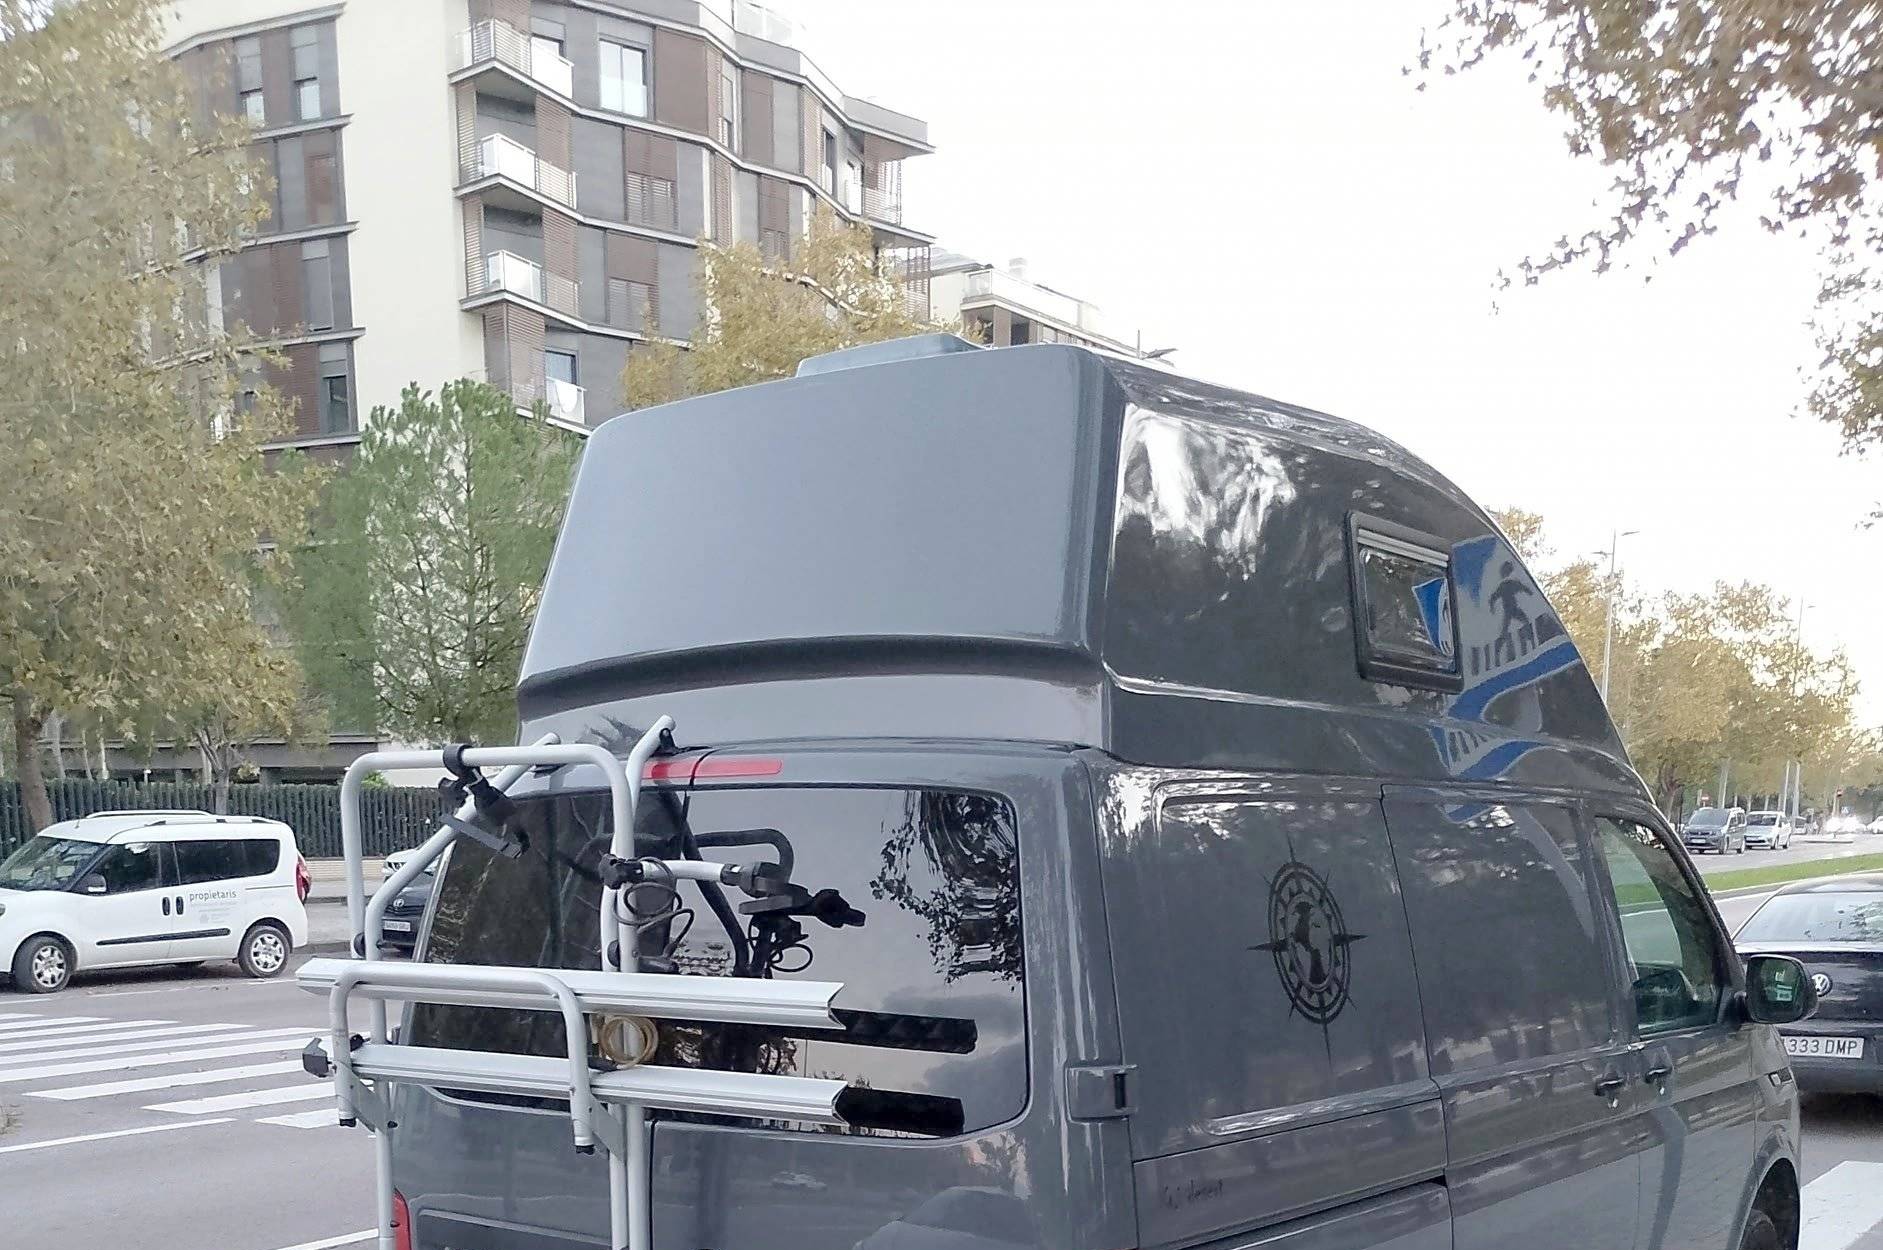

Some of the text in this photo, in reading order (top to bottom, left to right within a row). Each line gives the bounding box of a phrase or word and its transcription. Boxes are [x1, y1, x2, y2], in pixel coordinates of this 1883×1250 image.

[189, 889, 237, 902] propietaris
[1782, 1038, 1858, 1055] 333 DMP
